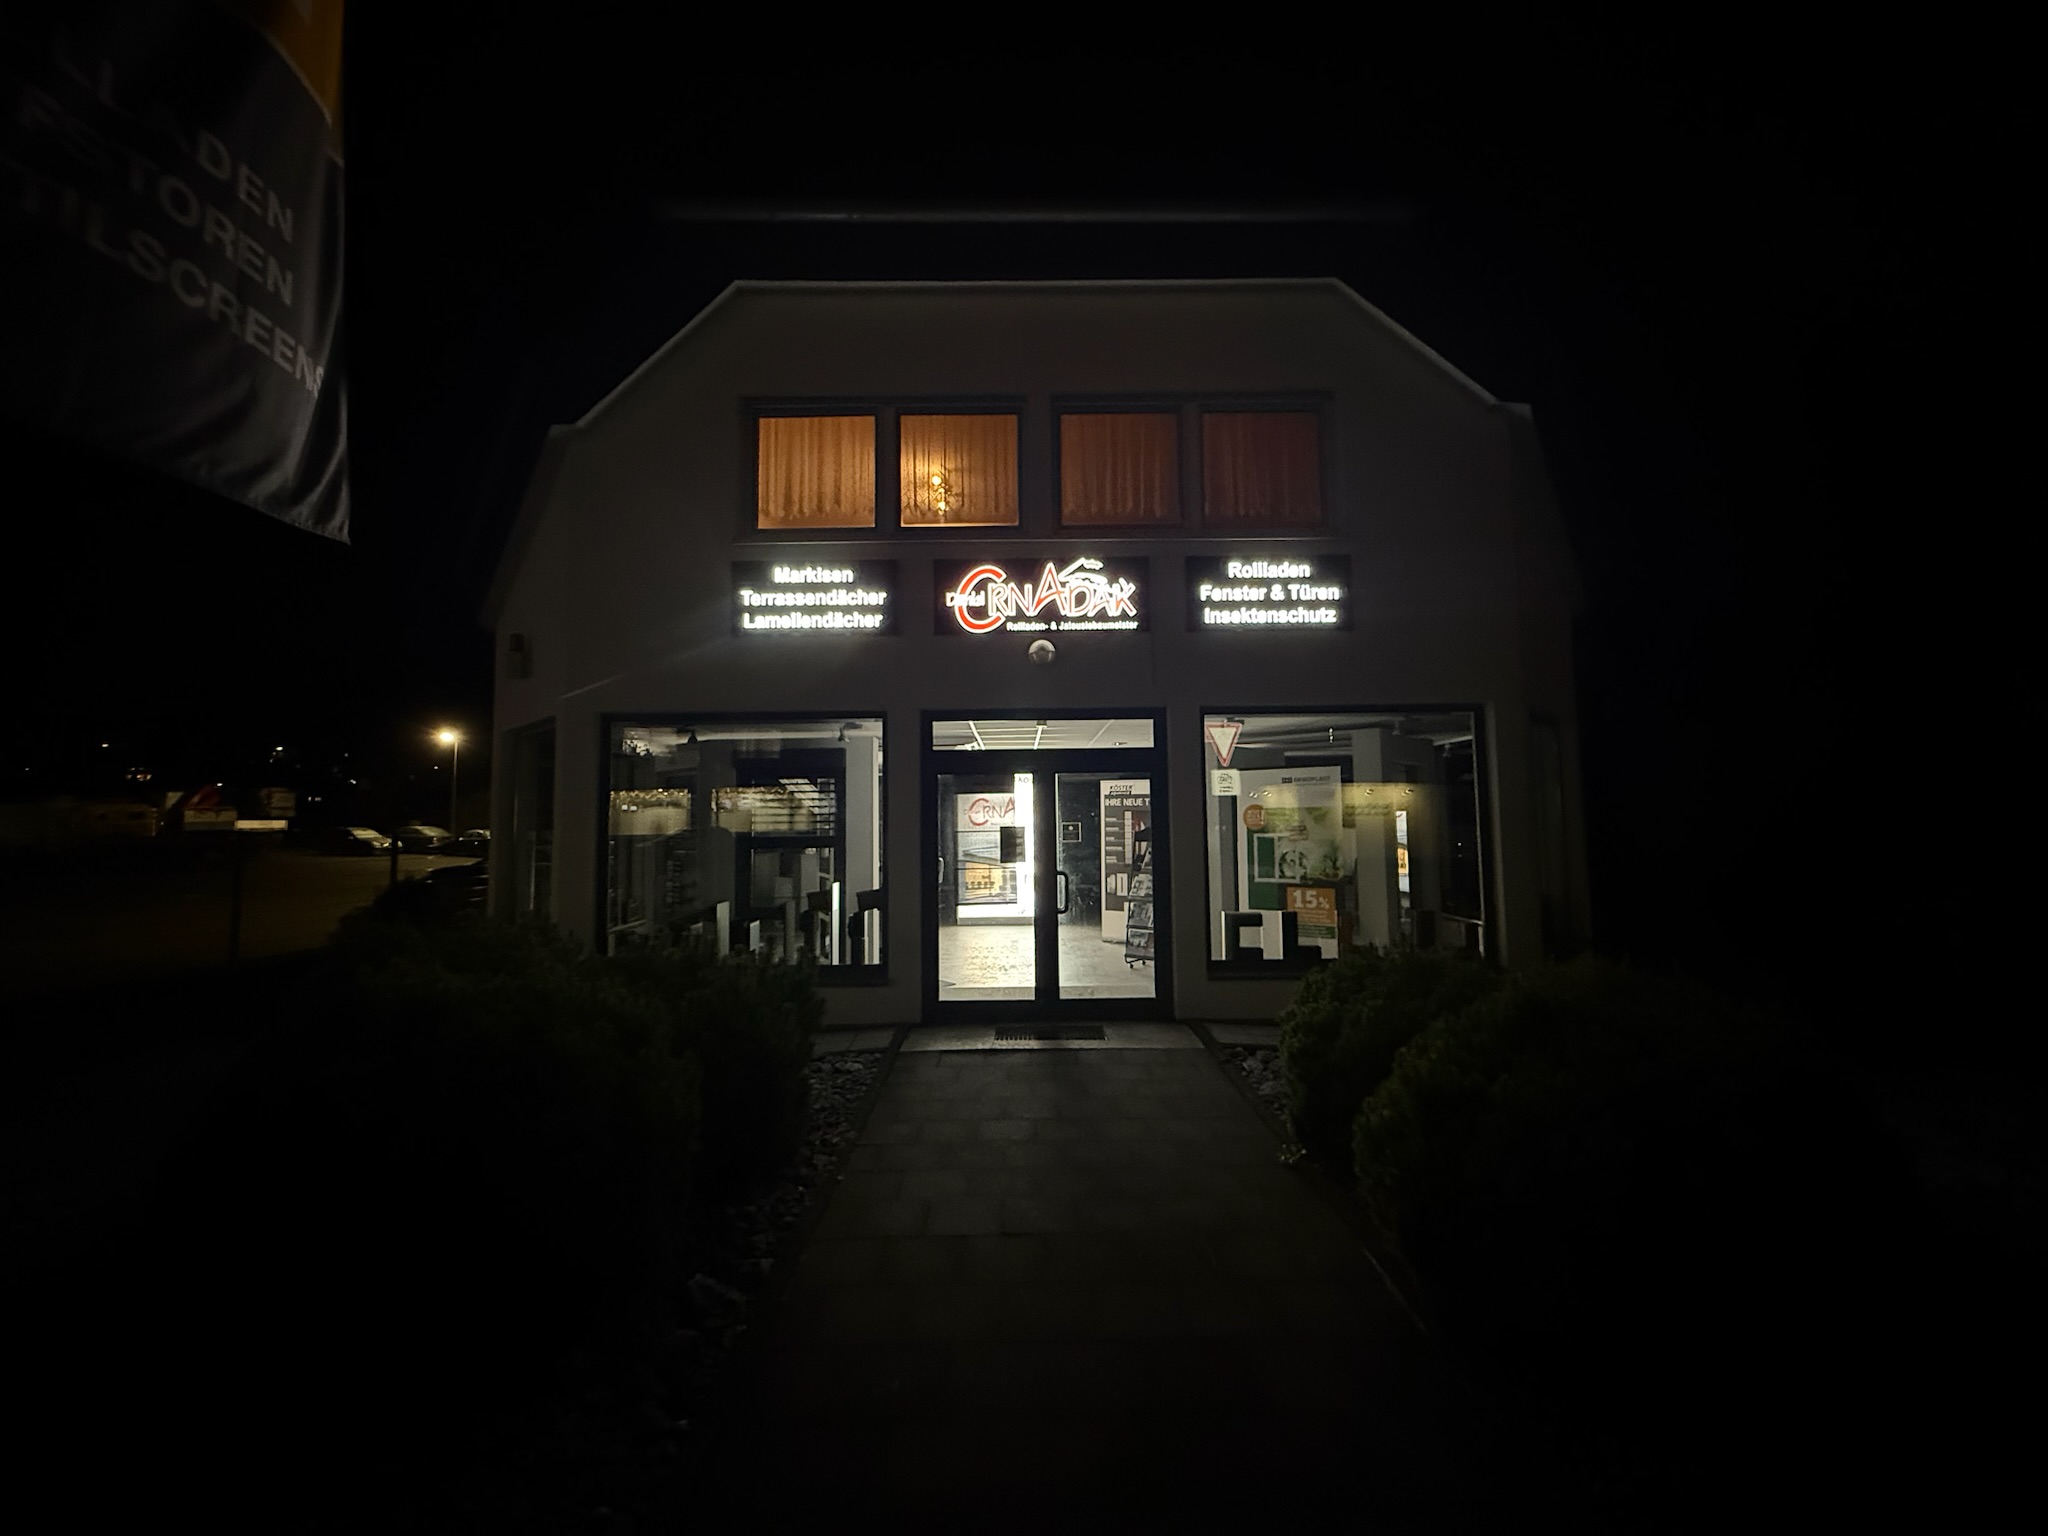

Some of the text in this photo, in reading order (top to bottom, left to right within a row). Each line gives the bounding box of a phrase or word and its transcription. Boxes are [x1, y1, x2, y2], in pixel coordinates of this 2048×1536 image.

[773, 566, 854, 583] Markisen
[740, 588, 888, 606] Terrassendächer
[1200, 583, 1341, 601] Fenster & Türen
[743, 611, 884, 629] Lamellendächer
[1204, 606, 1337, 624] Insektenschutz
[1105, 798, 1122, 807] IHRE
[1123, 798, 1143, 807] NEUE
[1293, 889, 1330, 910] 15%
